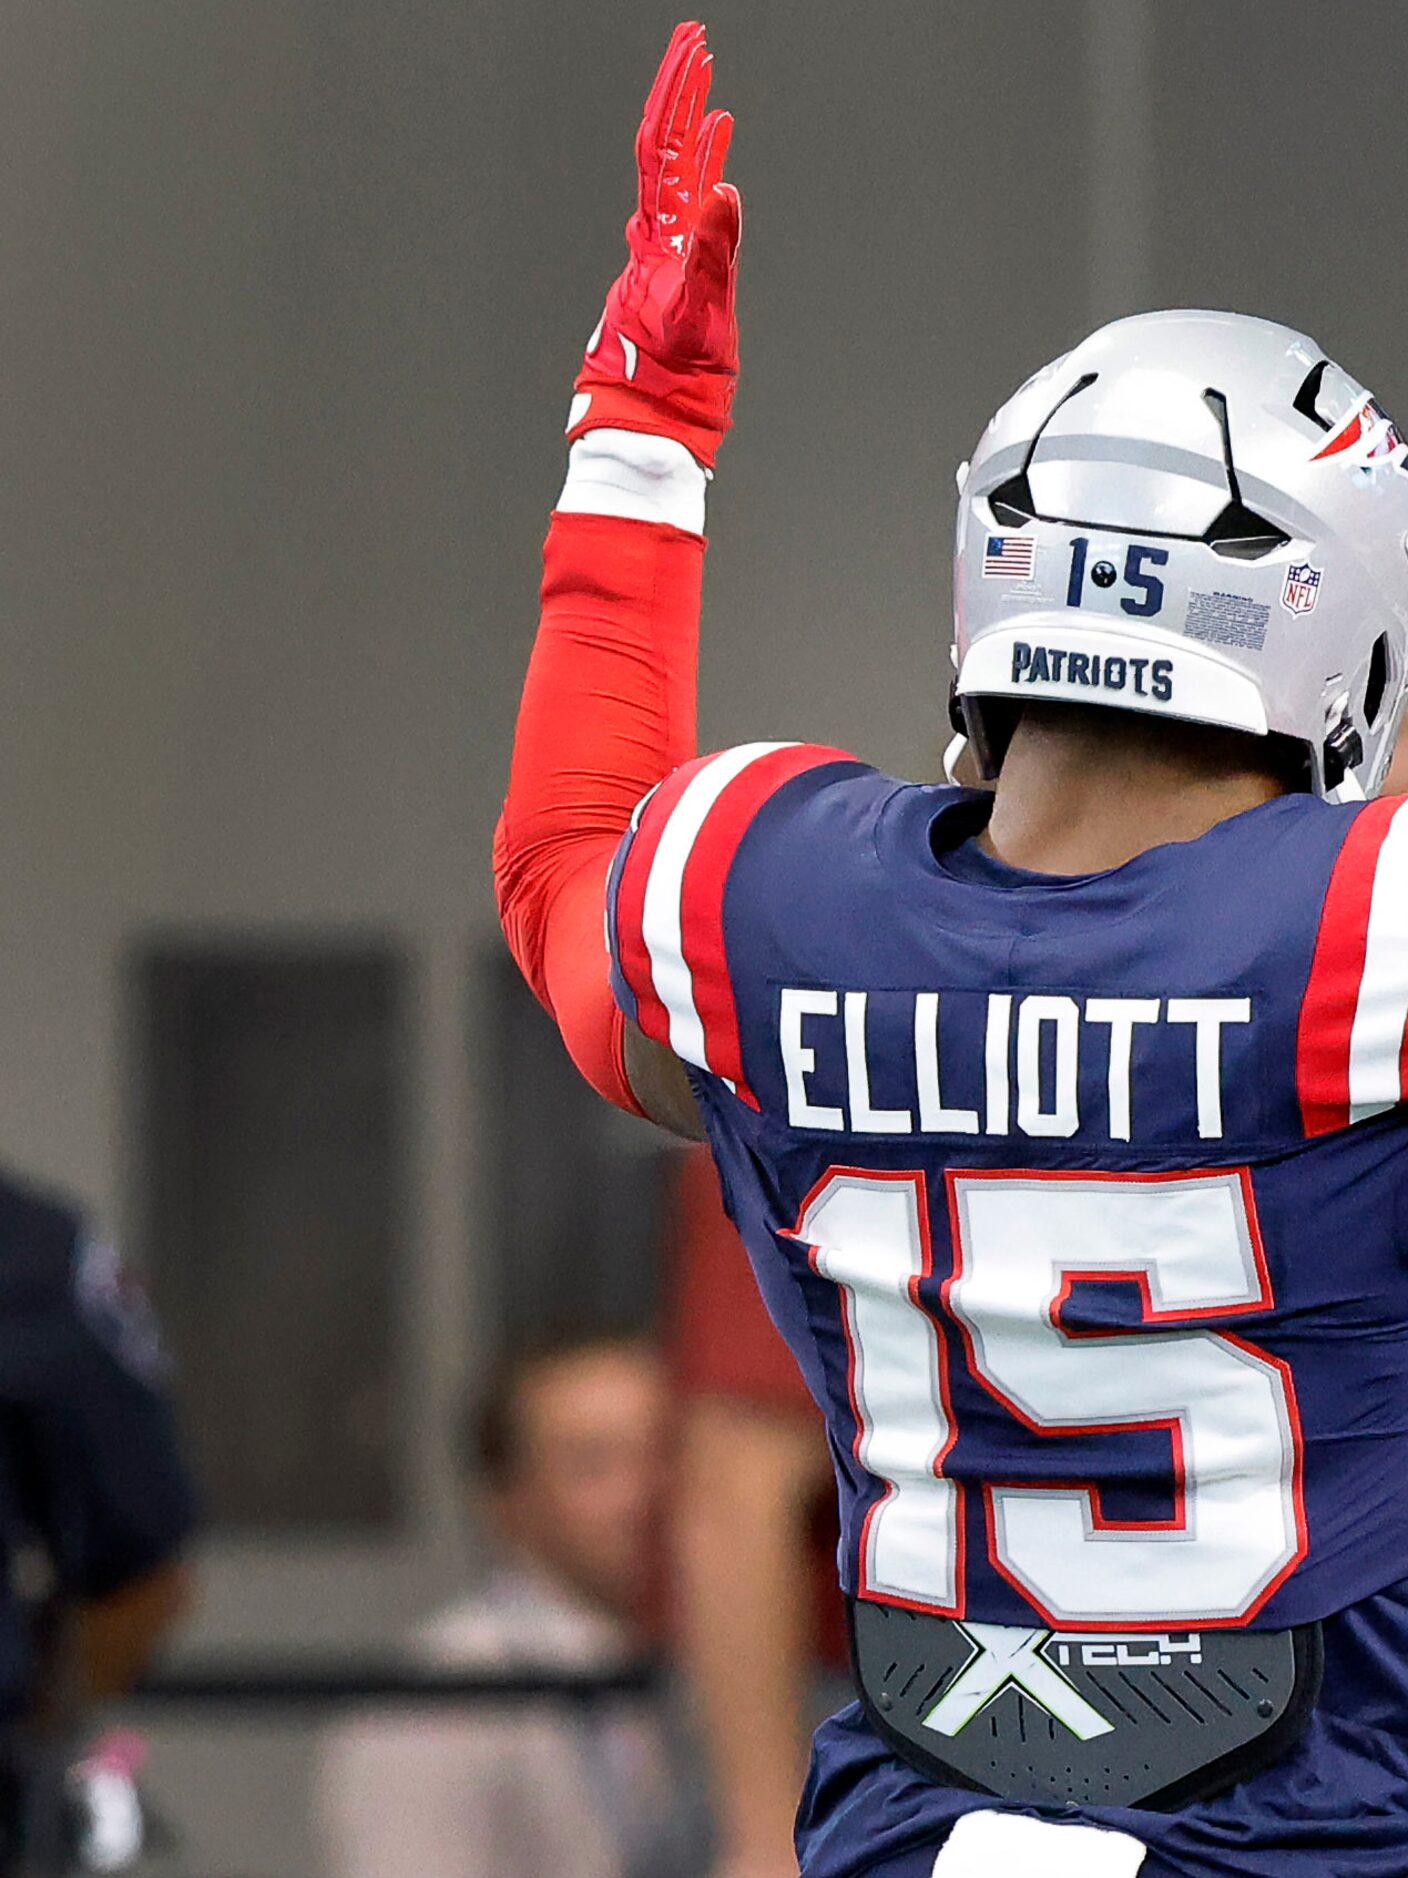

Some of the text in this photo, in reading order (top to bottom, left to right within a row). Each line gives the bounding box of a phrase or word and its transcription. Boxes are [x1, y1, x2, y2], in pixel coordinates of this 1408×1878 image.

[1286, 583, 1312, 609] NFL
[1011, 641, 1173, 701] PATRIOTS
[780, 988, 1251, 1142] ELLIOTT
[777, 1164, 1309, 1630] 15
